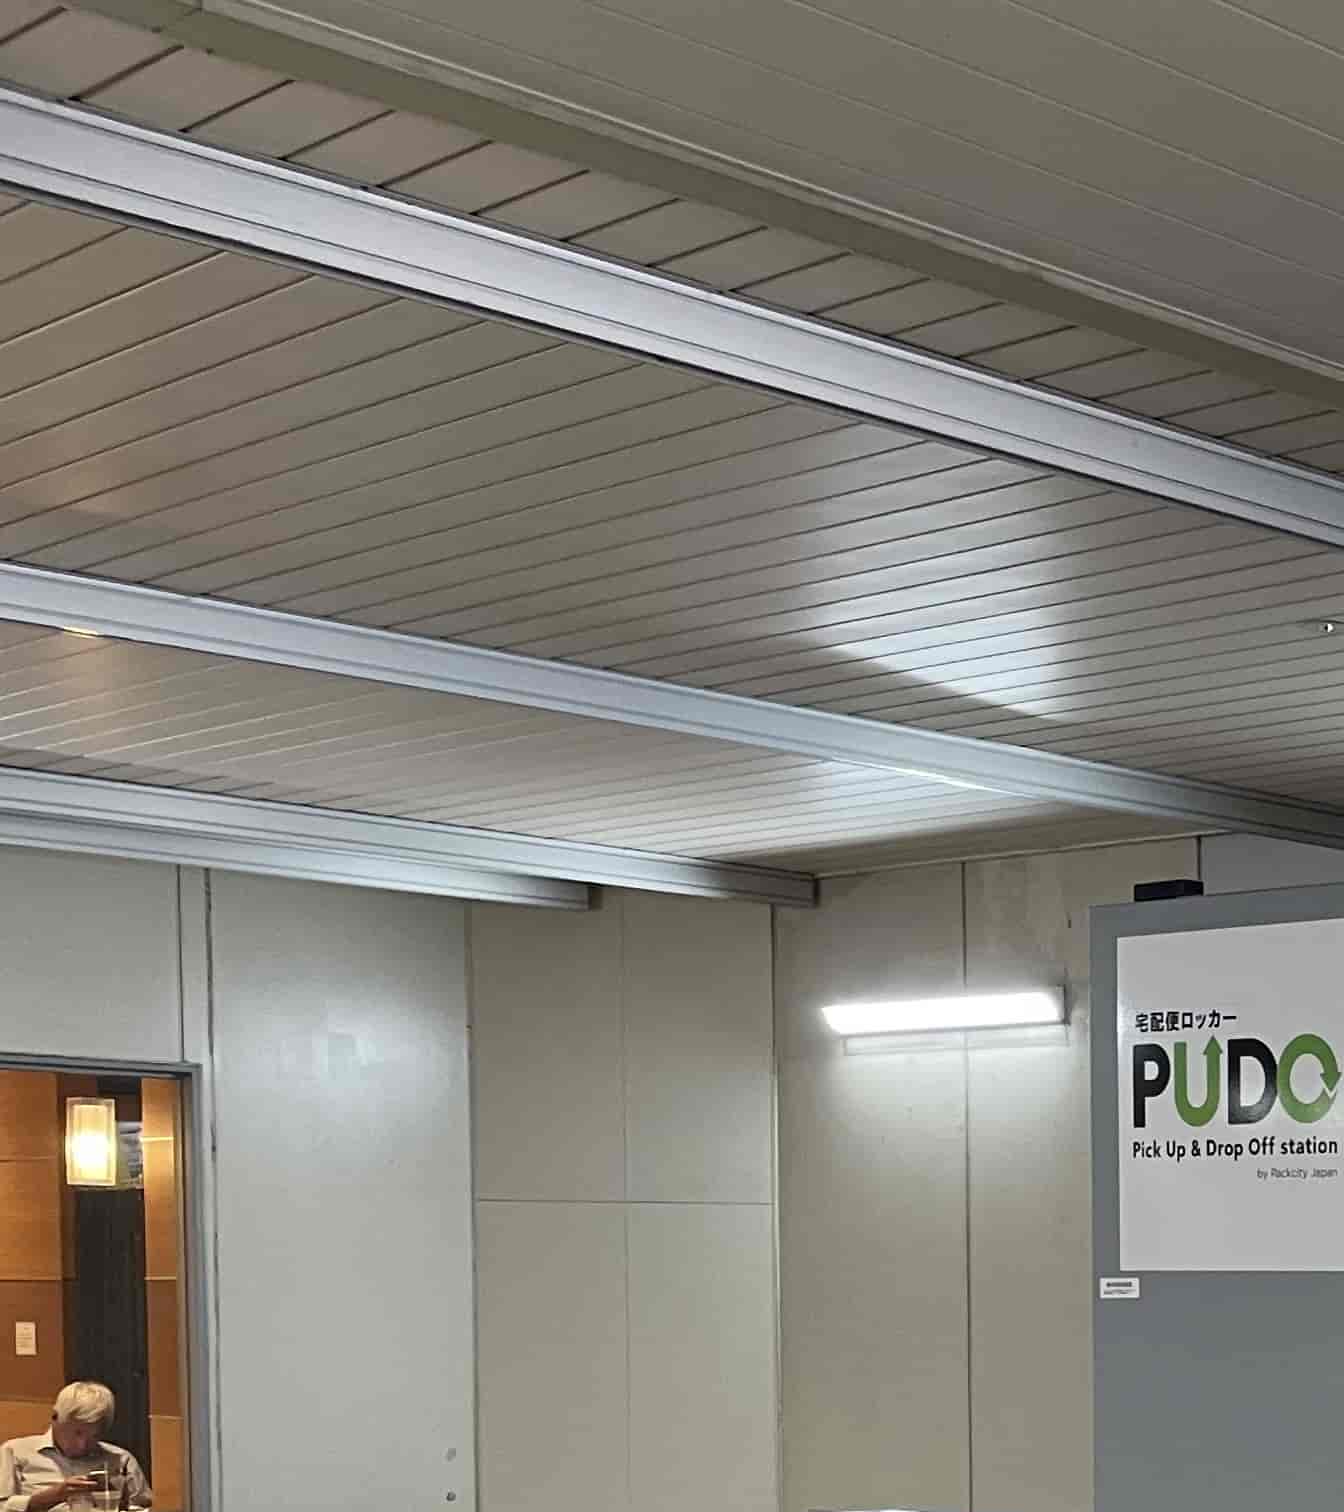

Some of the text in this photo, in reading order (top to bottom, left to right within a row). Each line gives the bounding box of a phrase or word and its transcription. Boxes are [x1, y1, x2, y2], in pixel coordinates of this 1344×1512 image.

[1134, 1010, 1237, 1033] 宅配便ロッカー
[1132, 1033, 1343, 1128] PUDO
[1132, 1136, 1339, 1163] Pick Up & Drop Off station
